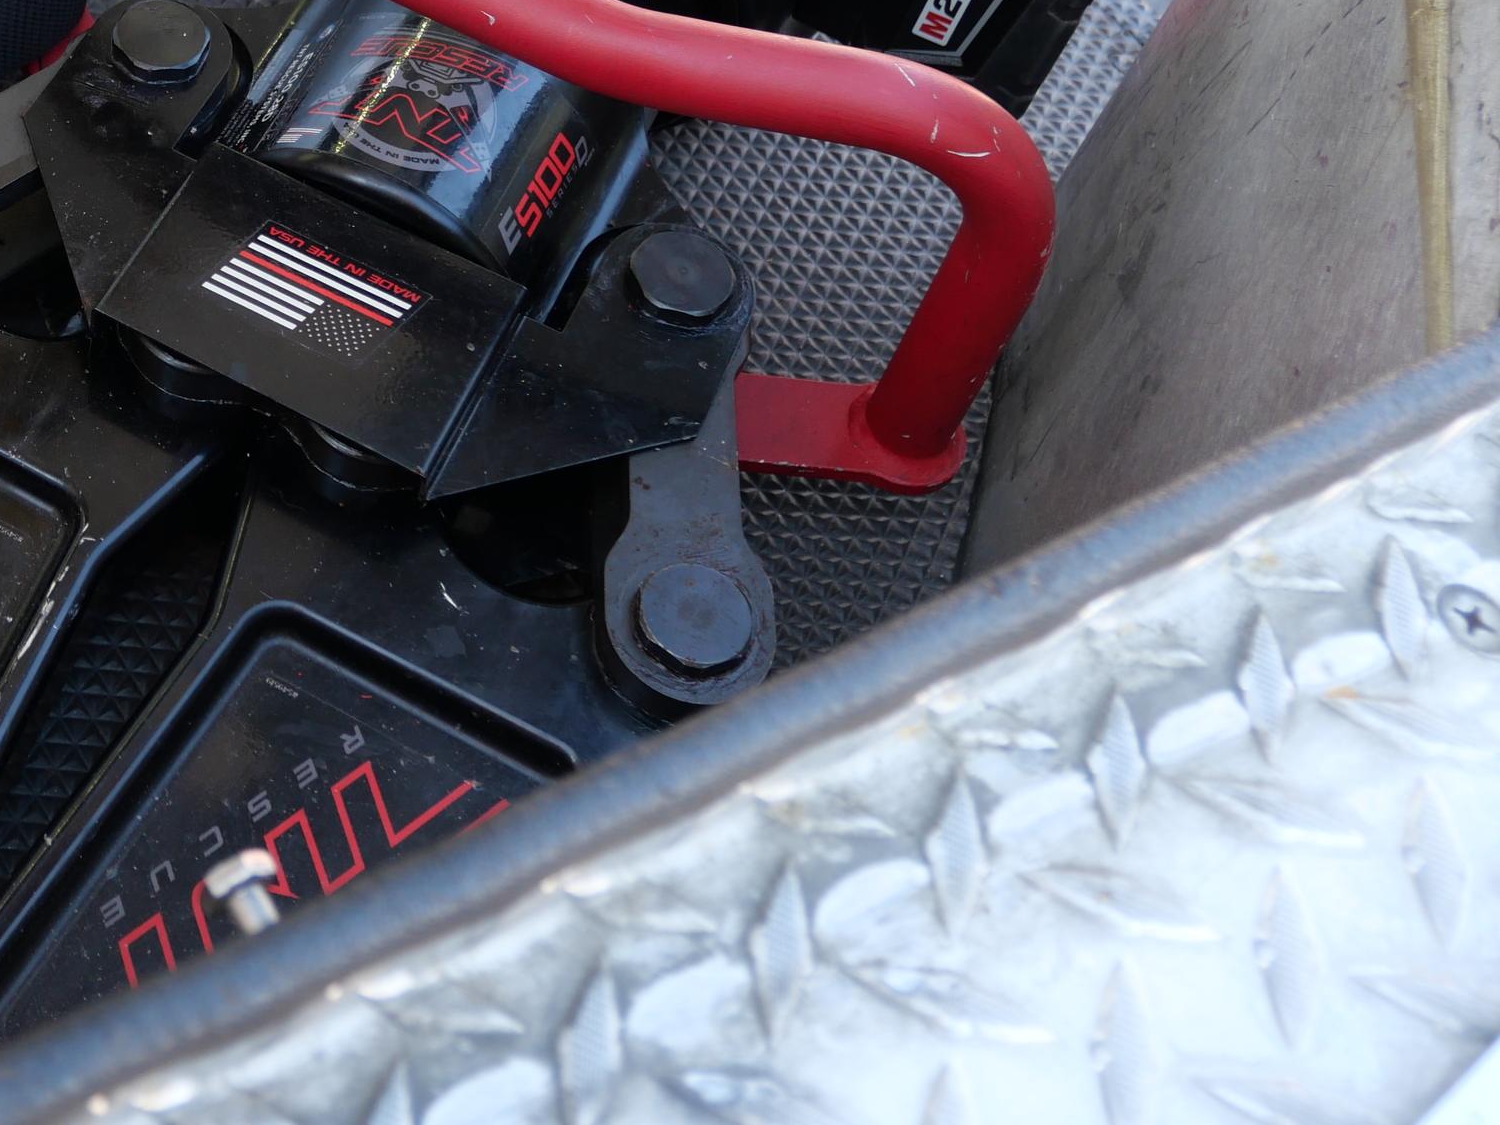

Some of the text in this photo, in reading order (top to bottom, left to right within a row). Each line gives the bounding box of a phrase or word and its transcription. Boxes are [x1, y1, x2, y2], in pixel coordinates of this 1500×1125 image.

[351, 36, 529, 92] RESCUE
[360, 138, 382, 156] THE
[385, 150, 401, 161] IN
[403, 155, 440, 165] MADE
[269, 226, 421, 303] MADE IN THE USA
